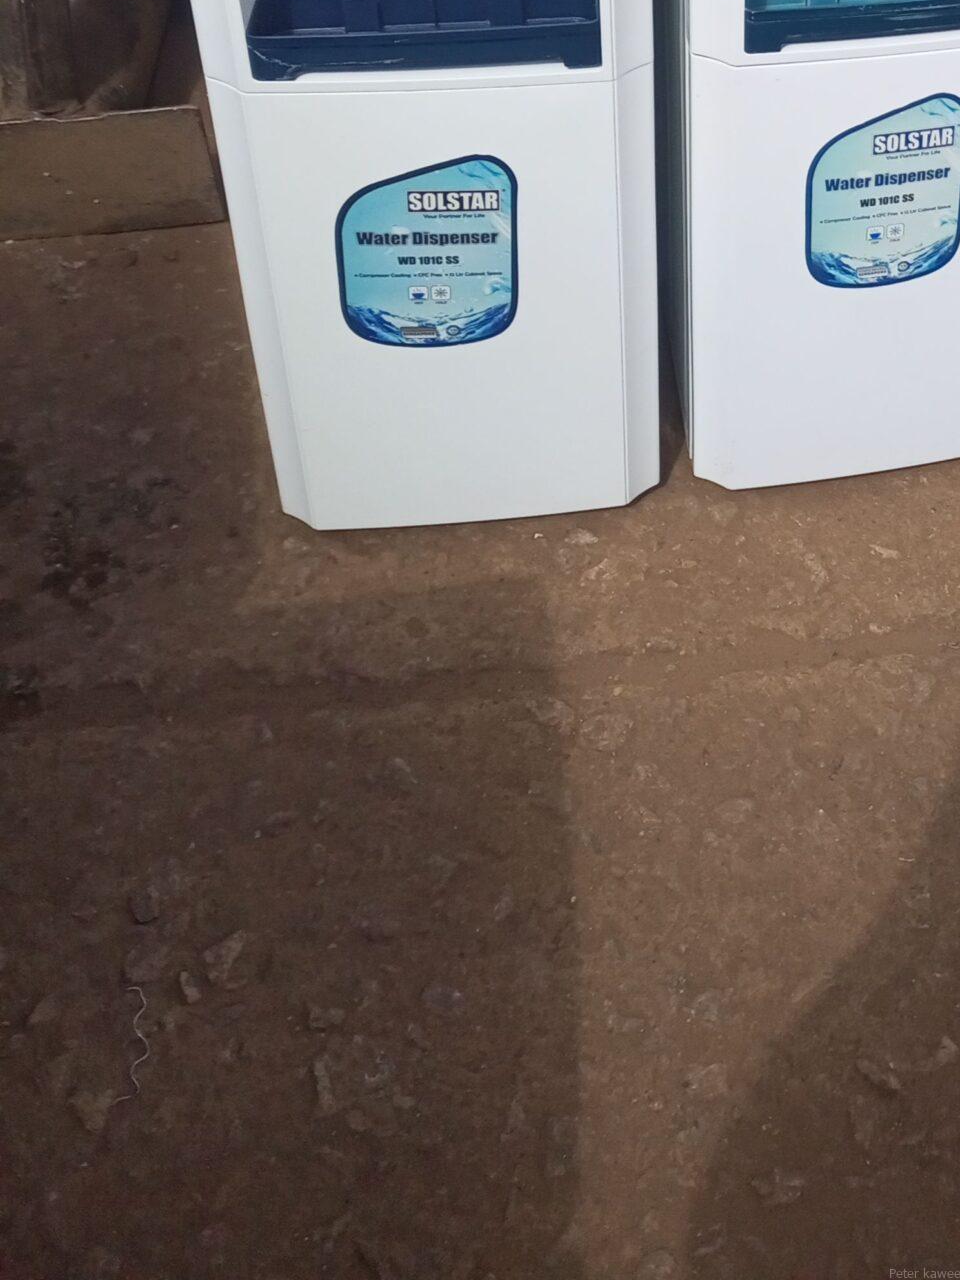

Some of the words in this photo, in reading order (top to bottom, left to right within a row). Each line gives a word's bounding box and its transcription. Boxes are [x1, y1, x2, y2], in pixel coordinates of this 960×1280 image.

[873, 127, 954, 154] SOLSTAR
[825, 176, 872, 193] Water
[874, 167, 951, 187] Dispenser
[408, 191, 499, 211] SOLSTAR
[860, 198, 876, 208] WD
[878, 195, 900, 206] 101C
[902, 193, 915, 203] SS
[356, 231, 409, 246] Water
[411, 231, 499, 247] Dispenser
[397, 256, 417, 266] WD
[419, 256, 443, 266] 101C
[445, 255, 460, 265] SS
